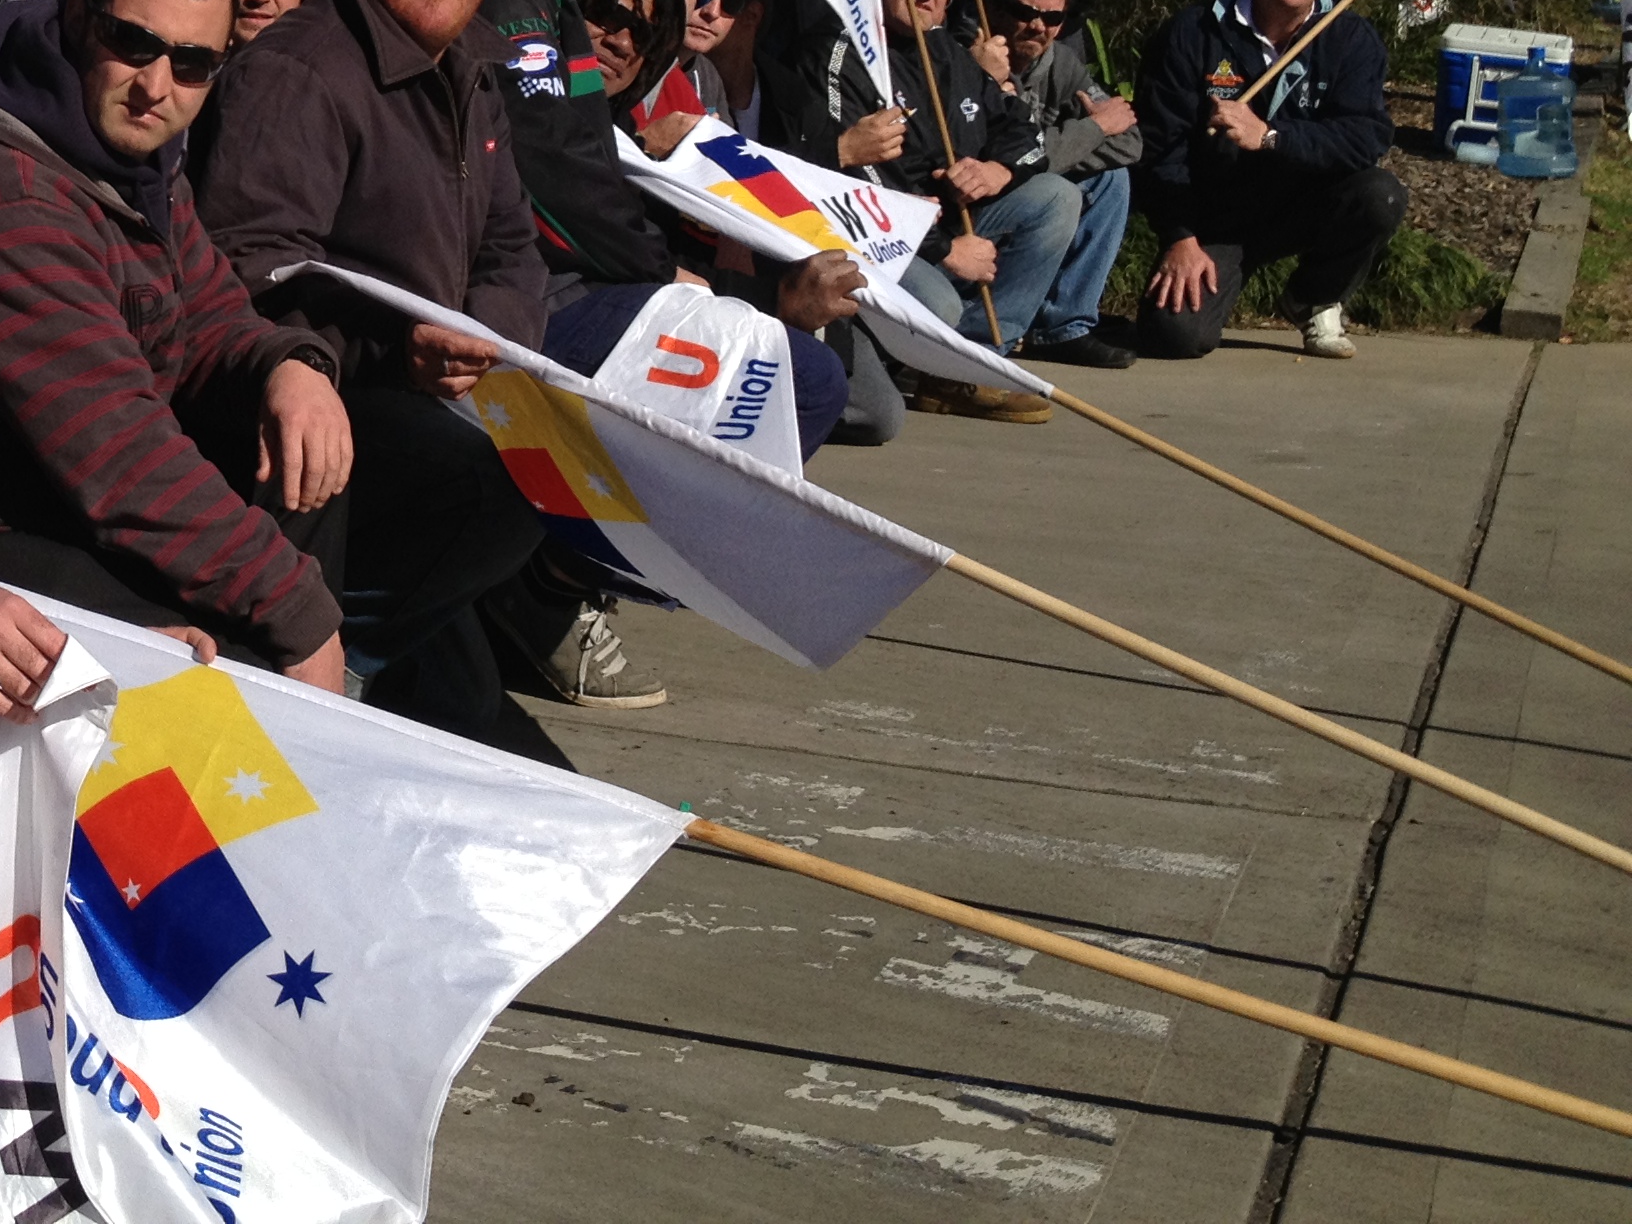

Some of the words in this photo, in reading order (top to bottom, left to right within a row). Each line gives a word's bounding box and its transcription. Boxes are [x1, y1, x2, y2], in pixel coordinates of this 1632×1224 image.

[868, 238, 913, 264] Union
[647, 334, 721, 389] U
[712, 358, 779, 440] Union
